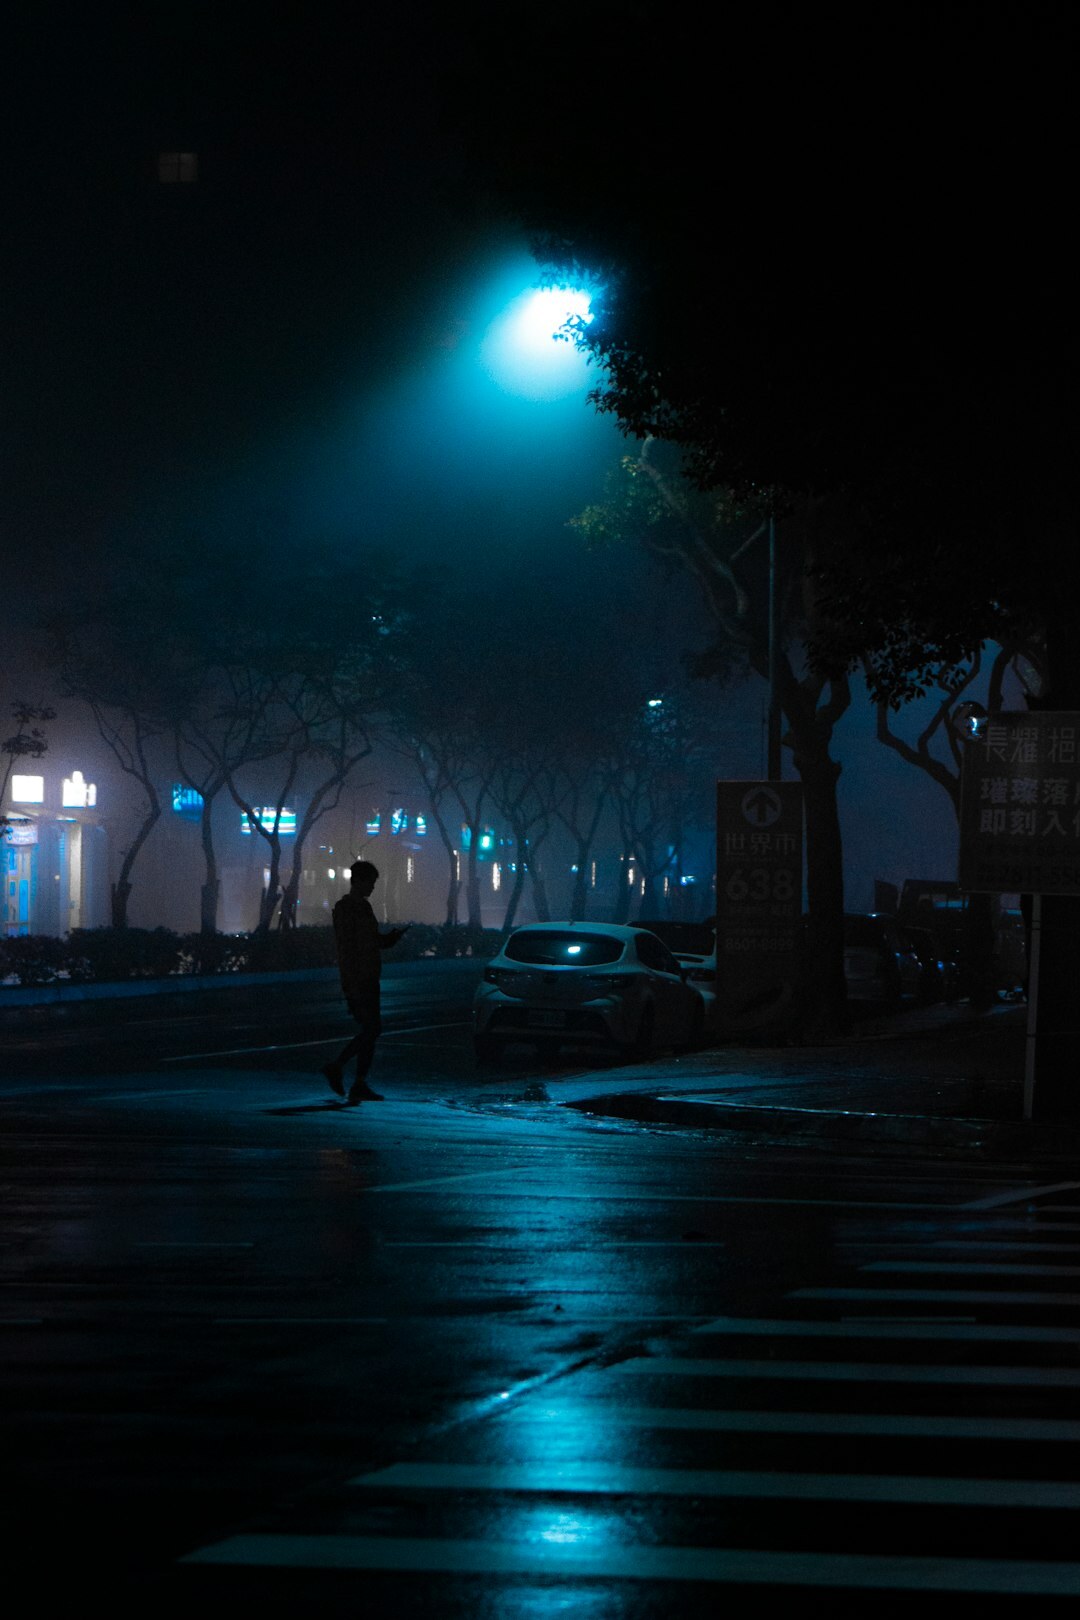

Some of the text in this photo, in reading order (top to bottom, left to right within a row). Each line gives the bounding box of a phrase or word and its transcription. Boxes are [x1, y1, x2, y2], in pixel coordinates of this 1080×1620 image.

[724, 832, 797, 856] 世界市
[725, 868, 794, 901] 638
